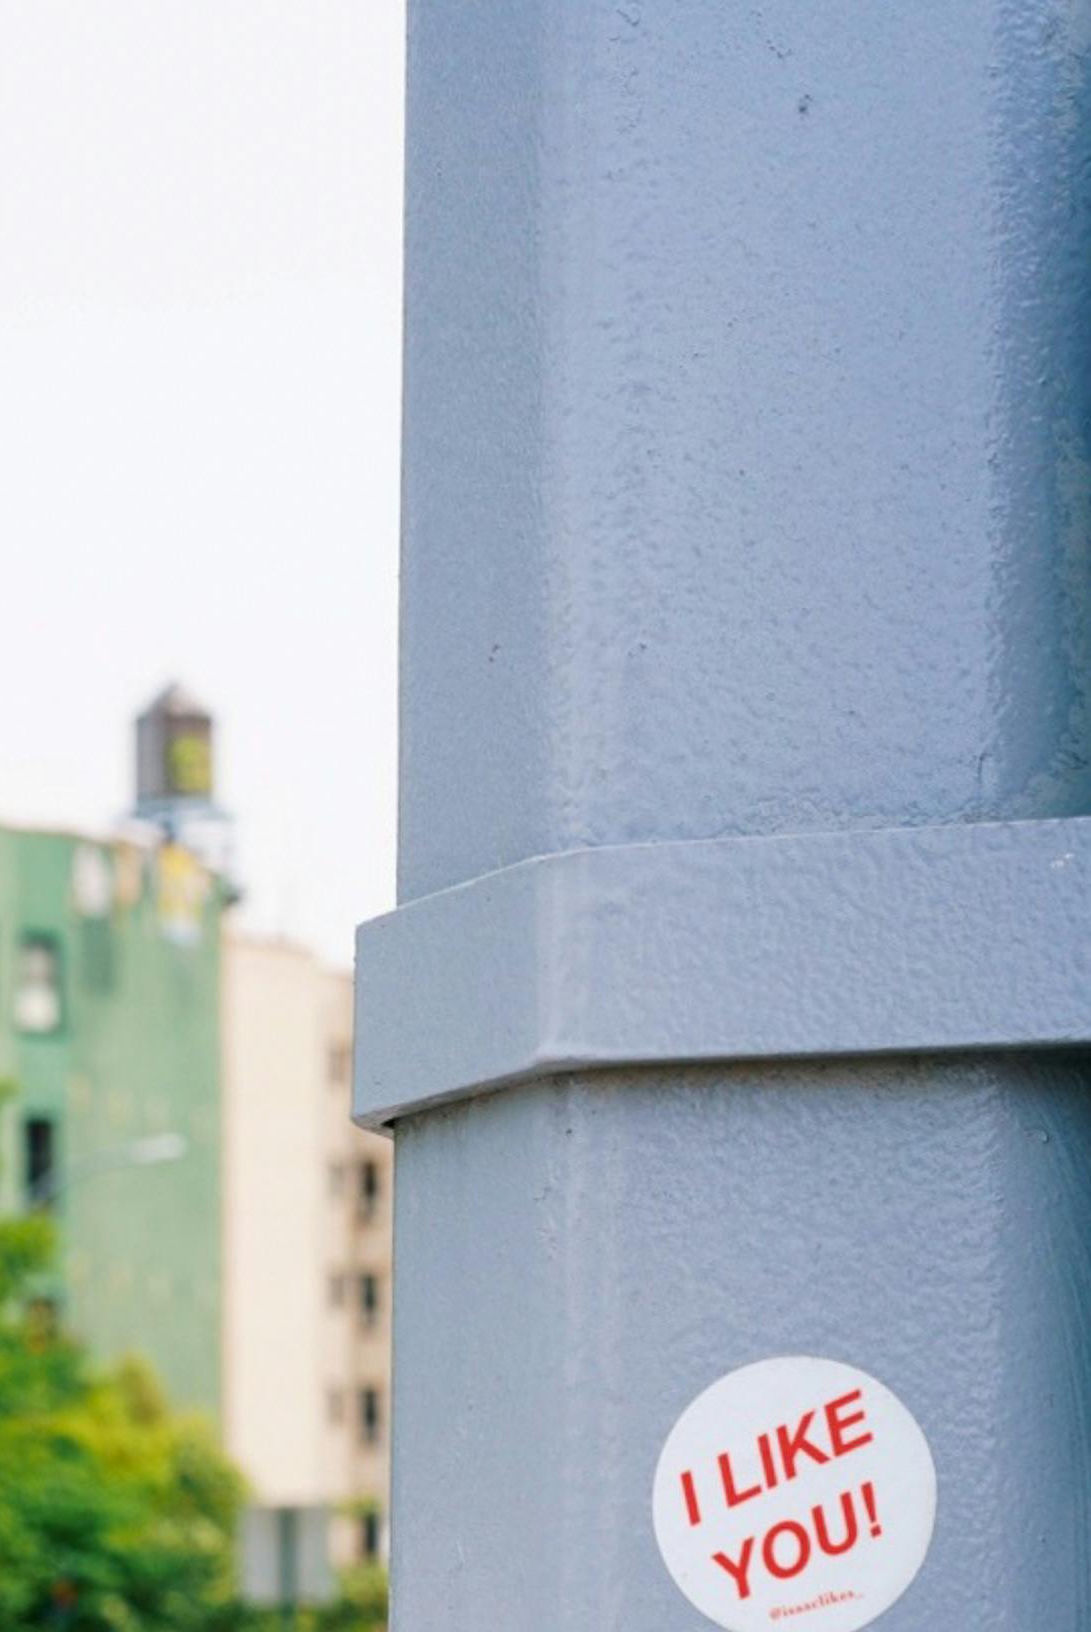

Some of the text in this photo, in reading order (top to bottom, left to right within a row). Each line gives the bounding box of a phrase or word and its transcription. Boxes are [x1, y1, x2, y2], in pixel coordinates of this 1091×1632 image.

[679, 1389, 873, 1526] I LIKE
[712, 1482, 882, 1600] YOU!
